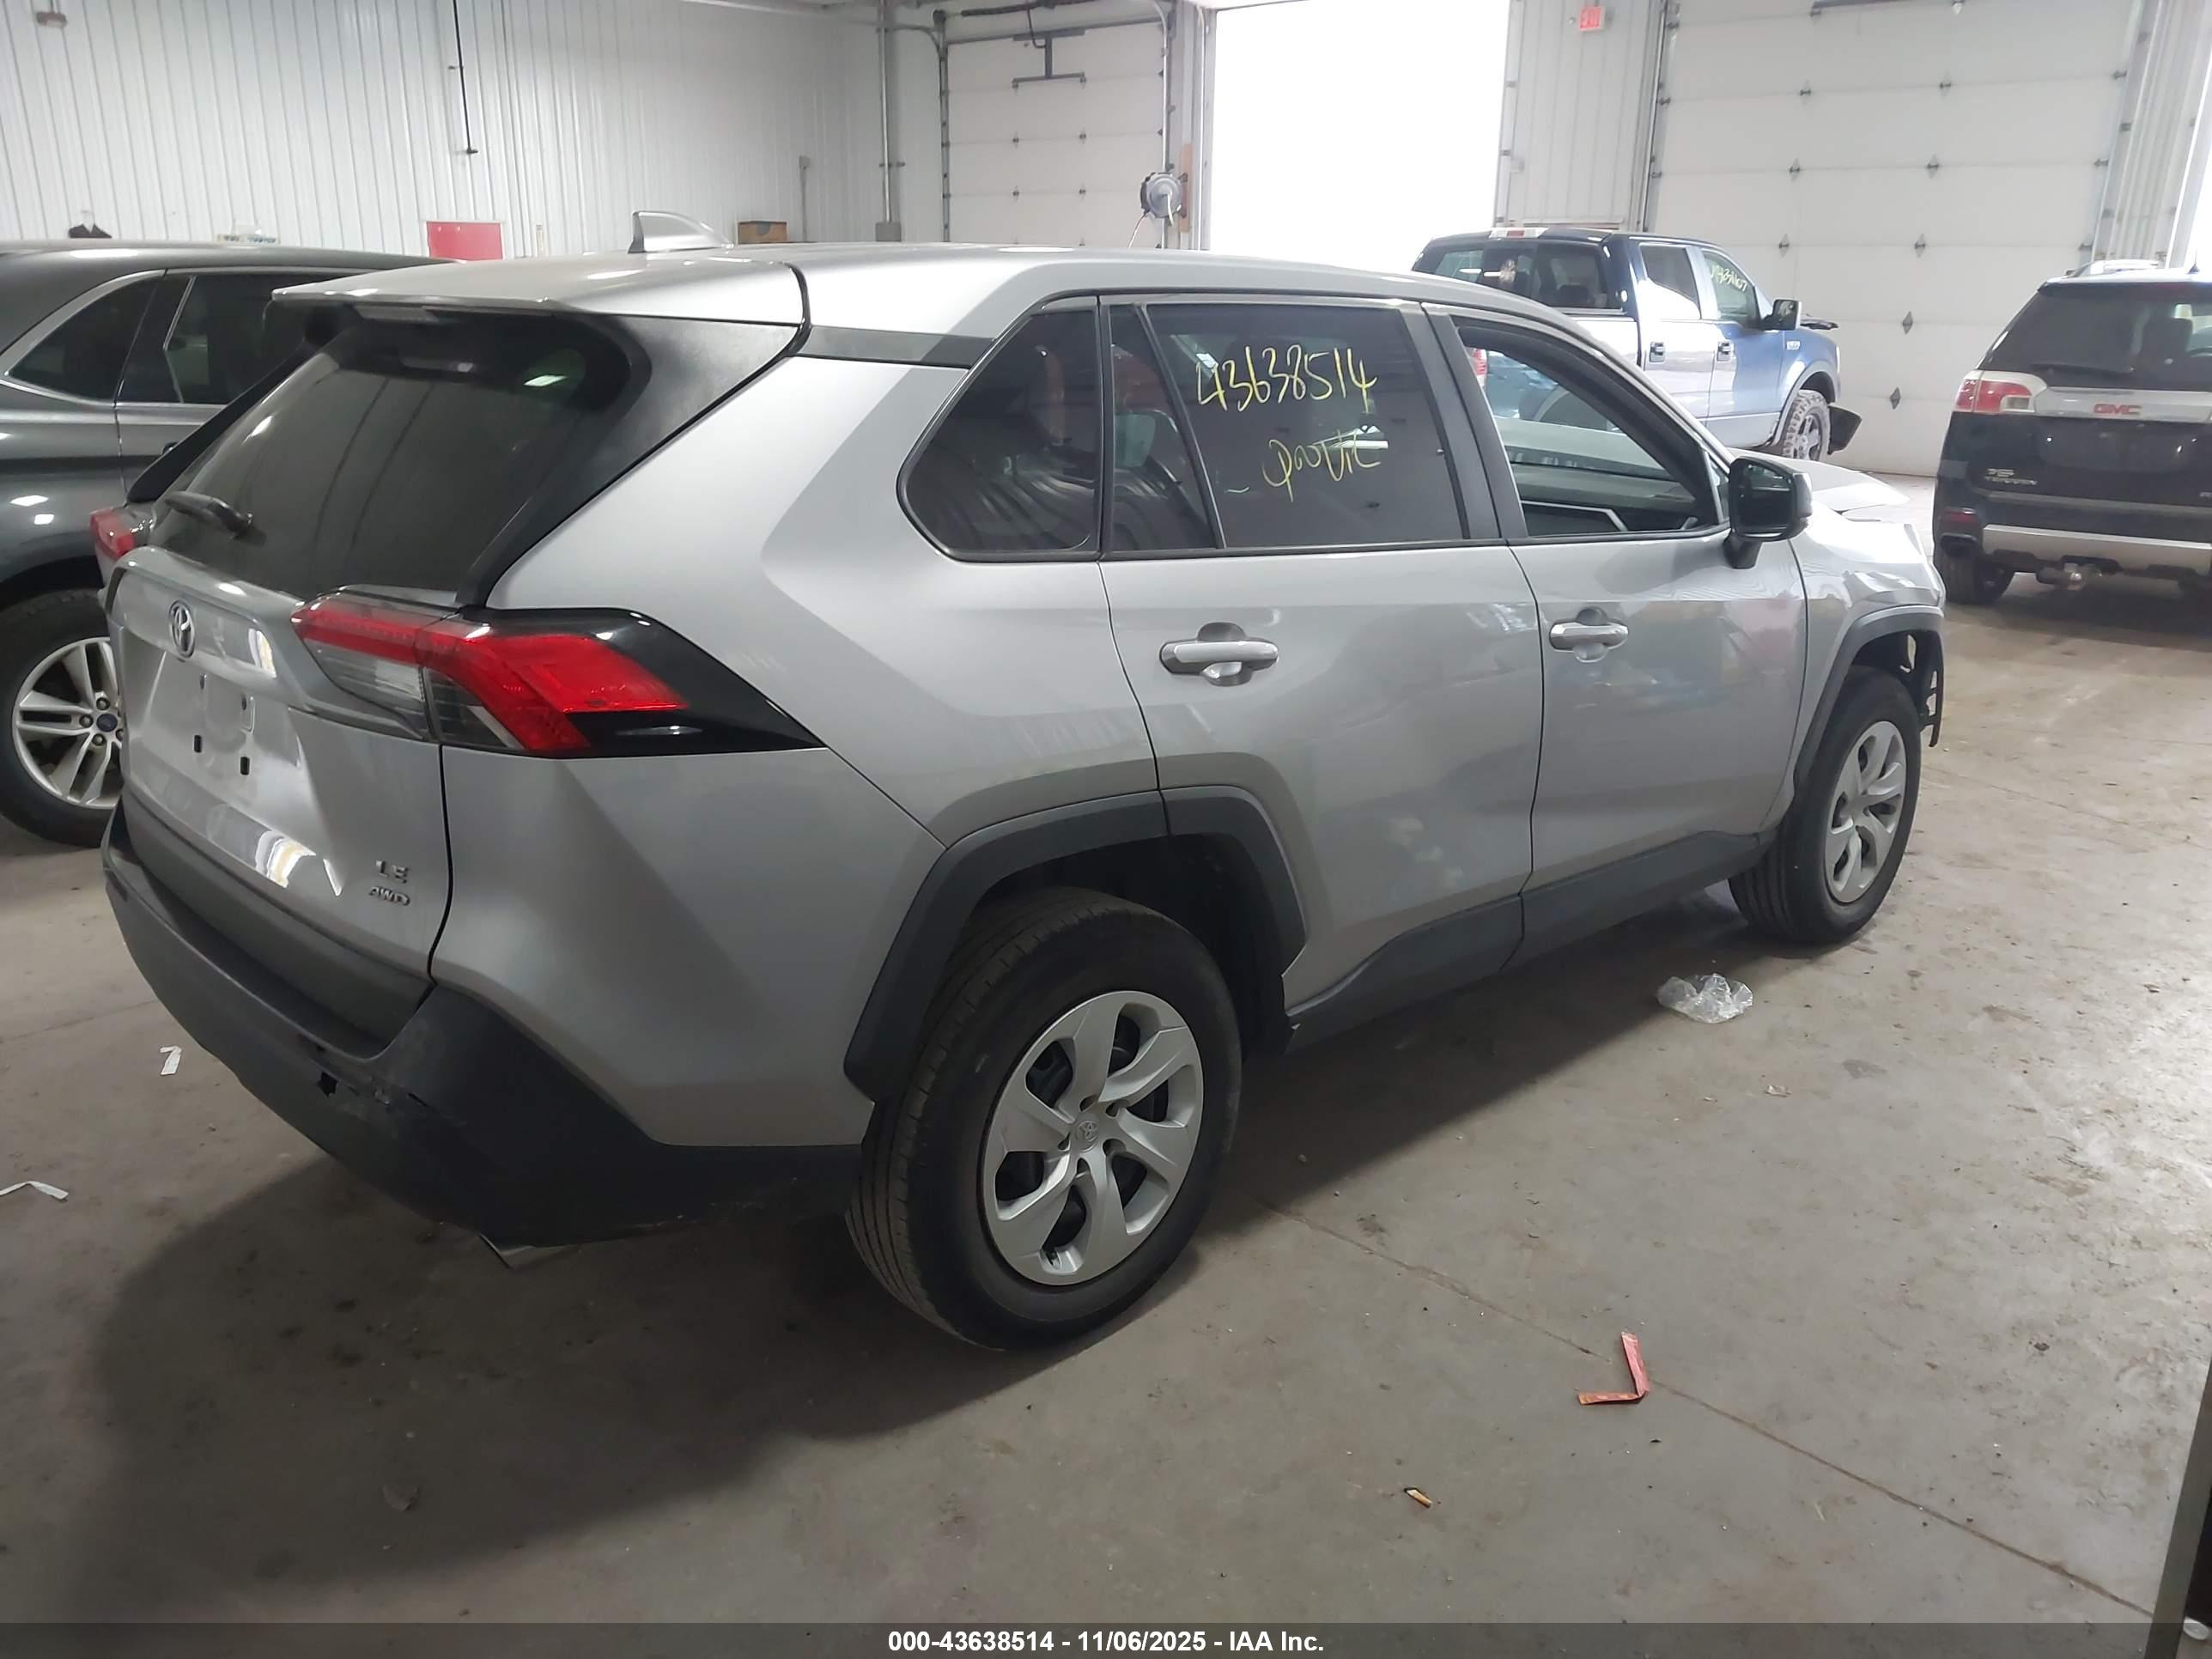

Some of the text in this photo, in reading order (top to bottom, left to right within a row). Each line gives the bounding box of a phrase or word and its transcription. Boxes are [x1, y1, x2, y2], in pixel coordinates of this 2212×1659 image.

[1195, 344, 1377, 413] 43638514
[2094, 404, 2142, 415] GMC
[375, 860, 410, 884] LE
[368, 886, 410, 906] AWD
